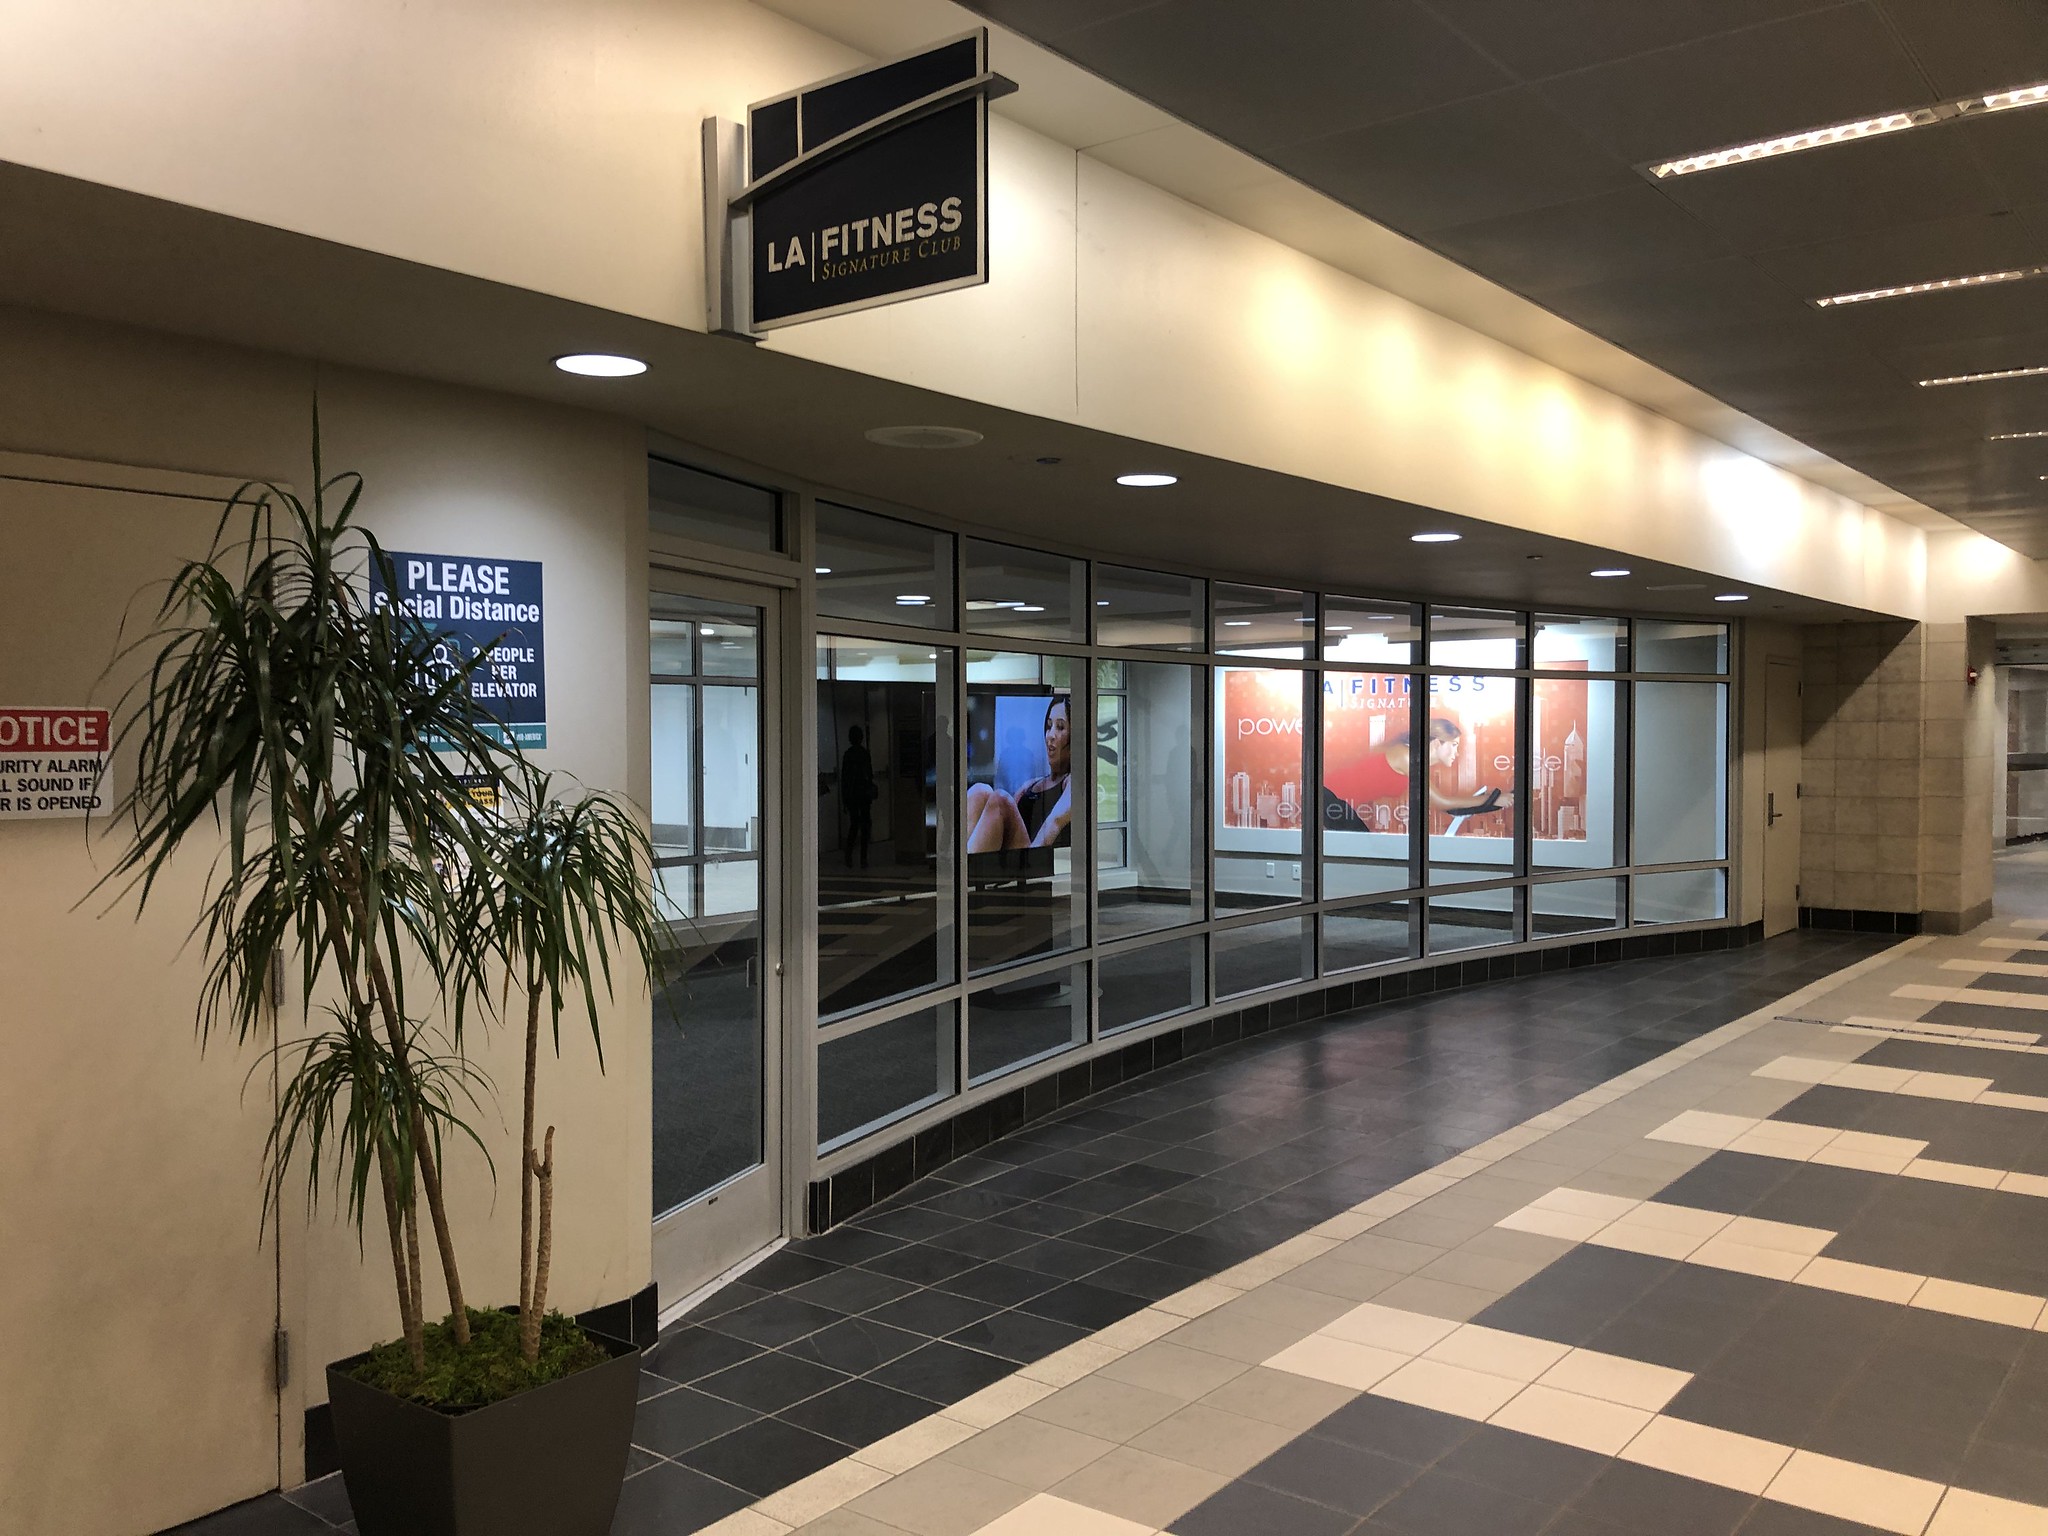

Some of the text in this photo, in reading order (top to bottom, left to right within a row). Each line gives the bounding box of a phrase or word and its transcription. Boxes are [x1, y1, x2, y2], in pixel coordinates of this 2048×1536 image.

[768, 196, 962, 273] LA FITNESS
[822, 235, 961, 281] SIGNATURE CLUB
[408, 560, 510, 595] PLEASE
[450, 595, 540, 623] Distance
[471, 682, 538, 698] ELEVATOR
[47, 760, 102, 772] ALARM
[17, 778, 73, 792] SOUND
[79, 778, 92, 790] IF
[17, 797, 31, 811] IS
[38, 796, 101, 810] OPENED
